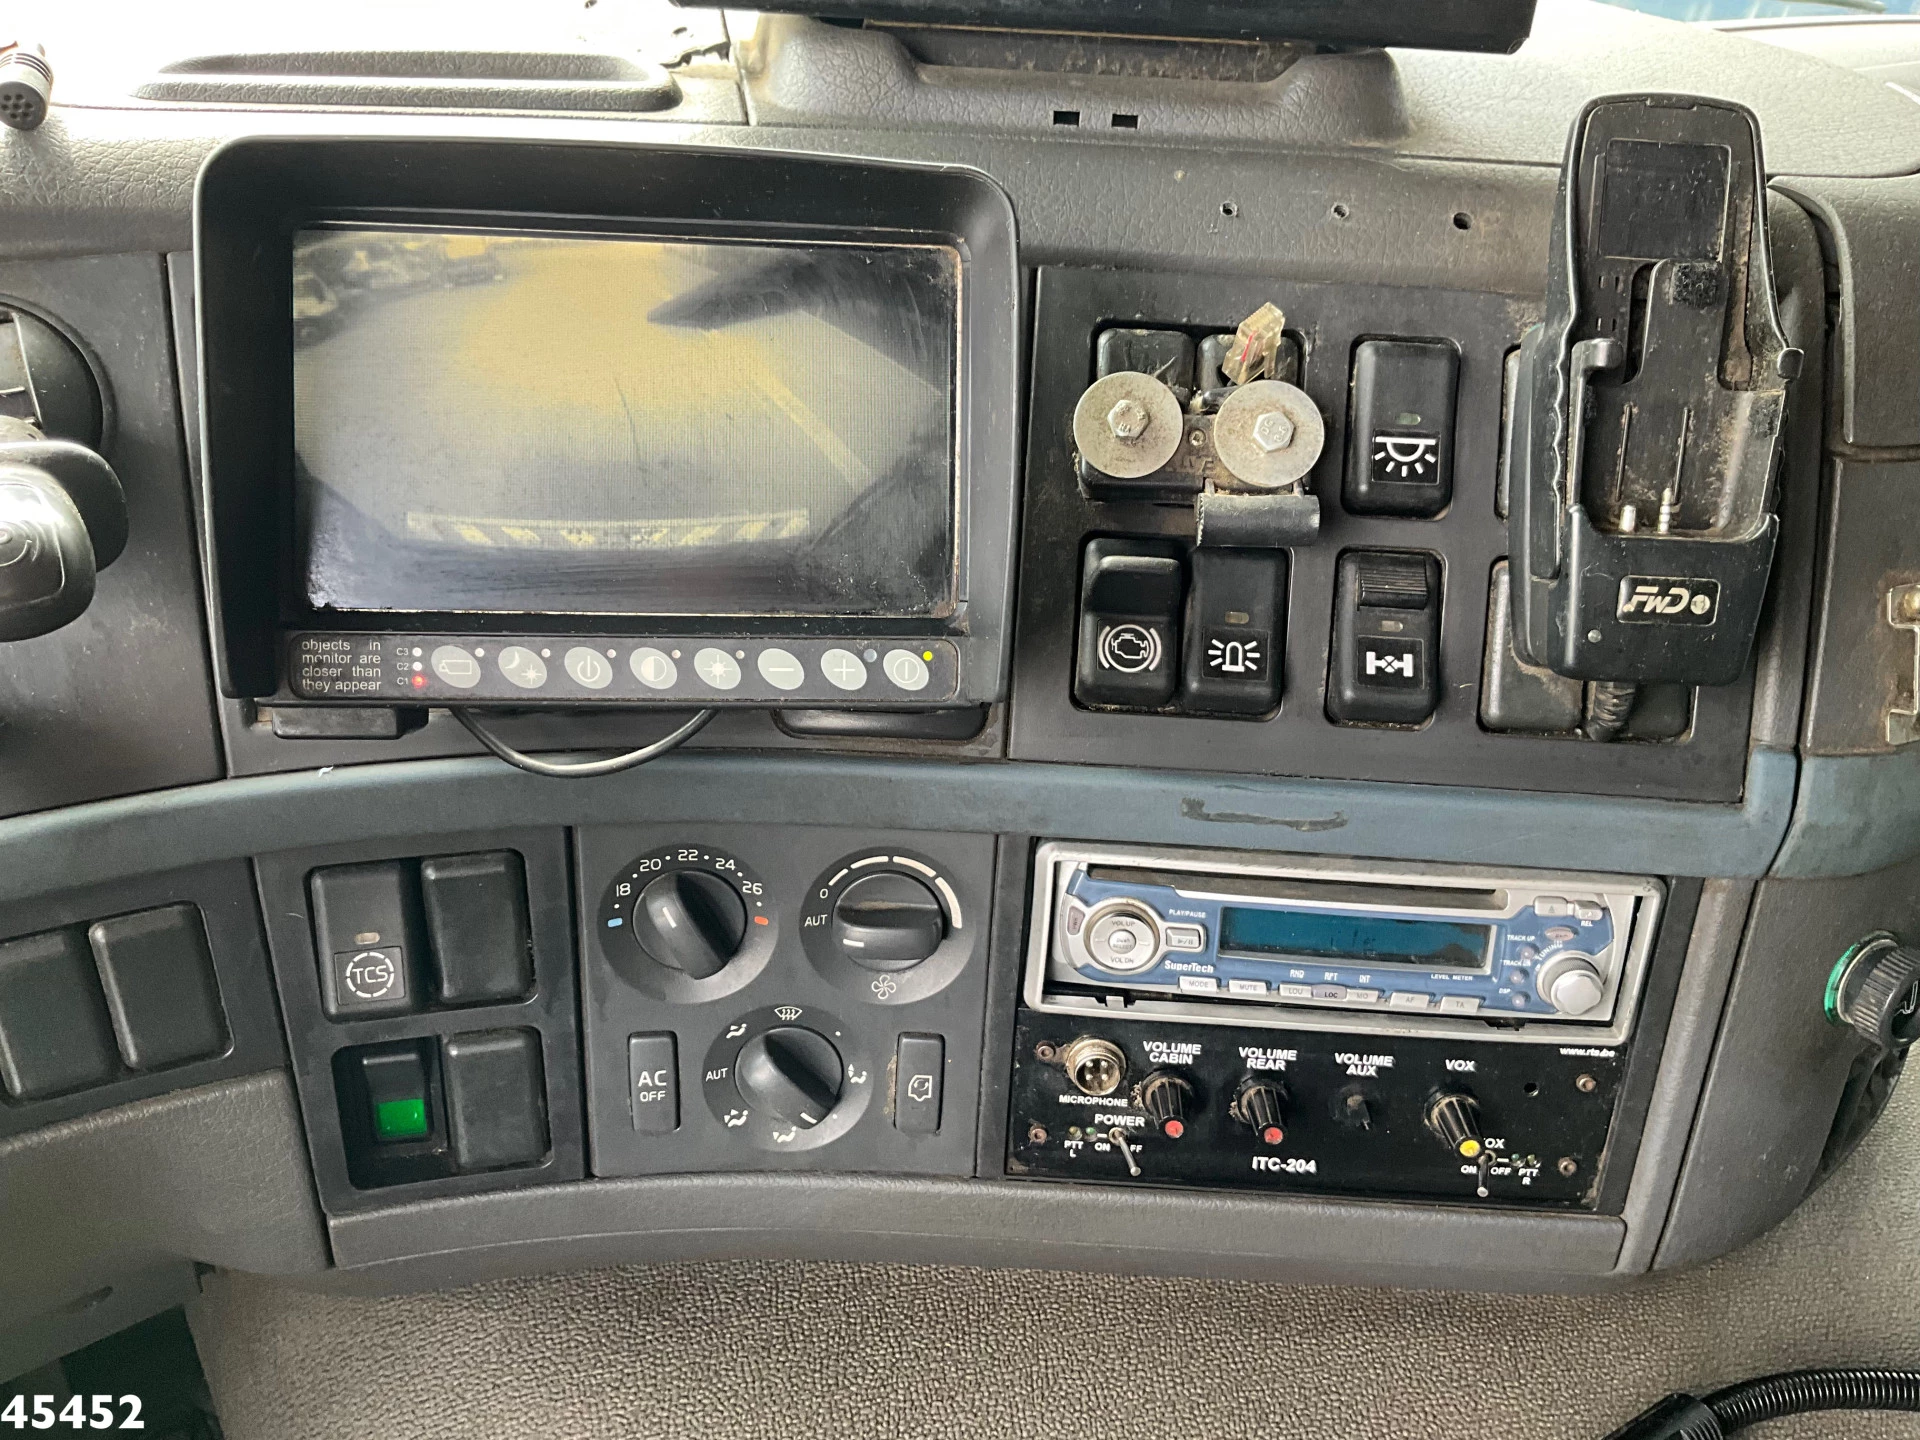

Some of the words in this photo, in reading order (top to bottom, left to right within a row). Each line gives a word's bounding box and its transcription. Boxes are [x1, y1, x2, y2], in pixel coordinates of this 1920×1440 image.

[302, 639, 350, 652] objects
[369, 640, 381, 651] in
[396, 647, 409, 656] C3
[302, 653, 352, 664] monitor
[359, 655, 381, 664] are
[302, 666, 342, 677] closer
[352, 666, 381, 677] than
[396, 662, 409, 671] C2
[302, 679, 331, 692] they
[335, 681, 381, 692] appear
[396, 677, 409, 685] C1
[677, 849, 699, 862] 22
[639, 857, 662, 872] 20
[715, 857, 736, 871] 24
[615, 882, 631, 897] 18
[742, 881, 763, 895] 26
[1168, 908, 1207, 918] PLAY/PAUSE
[804, 914, 828, 928] AUT
[1164, 960, 1214, 974] SuperTech
[352, 965, 388, 984] TCS
[1289, 969, 1304, 979] RND
[1324, 972, 1338, 981] RPT
[1359, 974, 1371, 984] INT
[1188, 980, 1209, 988] MODE
[1239, 983, 1258, 991] MUTE
[1324, 991, 1338, 999] LOC
[1143, 1040, 1201, 1055] VOLUME
[1238, 1046, 1297, 1061] VOLUME
[1149, 1052, 1194, 1065] CABIN
[1246, 1057, 1286, 1071] REAR
[1334, 1052, 1395, 1067] VOLUME
[1445, 1058, 1477, 1072] VOX
[705, 1067, 728, 1081] AUT
[1346, 1065, 1378, 1078] AUX
[638, 1069, 667, 1088] AC
[639, 1091, 666, 1102] OFF
[1058, 1094, 1128, 1107] MICROPHONE
[1094, 1113, 1145, 1127] POWER
[1064, 1140, 1084, 1149] PTT
[1094, 1142, 1111, 1152] ON
[1483, 1137, 1505, 1149] OX
[1069, 1149, 1077, 1158] L
[1252, 1155, 1317, 1174] ITC-204
[1460, 1164, 1477, 1174] ON
[1490, 1167, 1511, 1176] OFF
[1518, 1168, 1539, 1177] PTT
[1521, 1176, 1531, 1185] R
